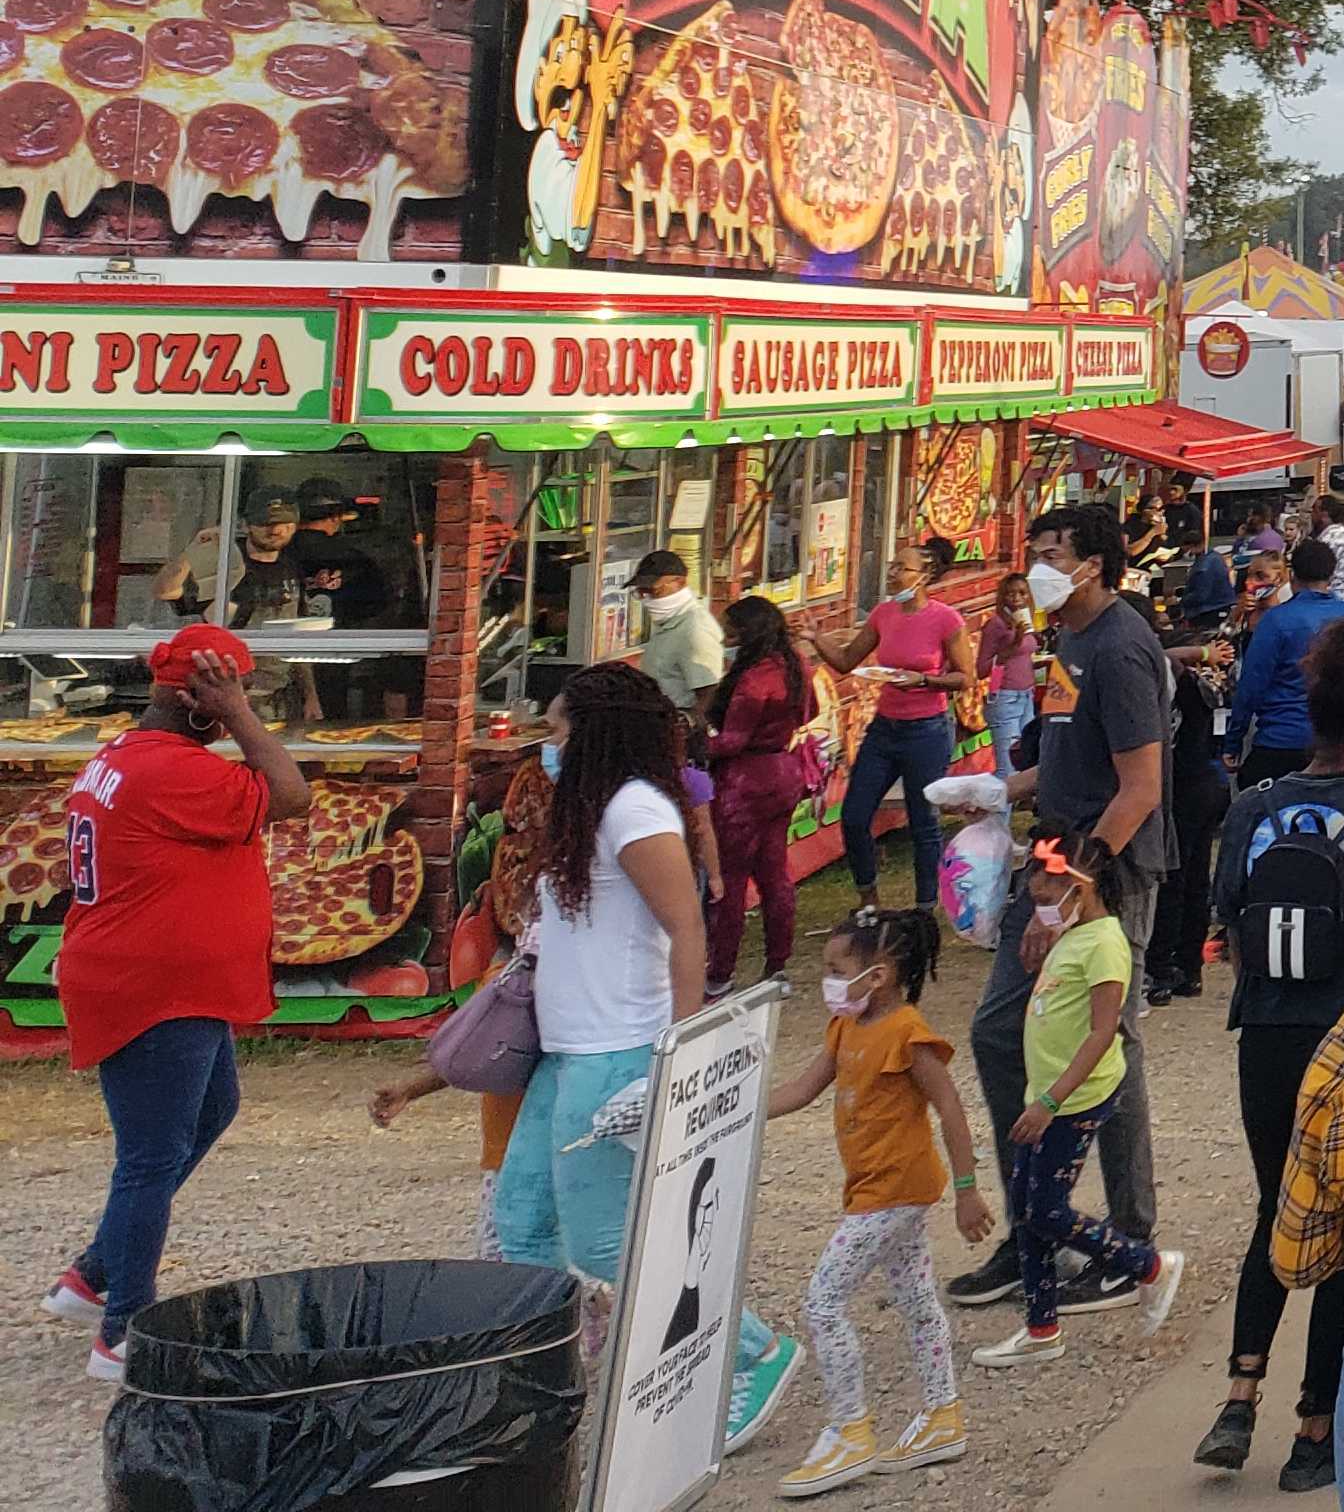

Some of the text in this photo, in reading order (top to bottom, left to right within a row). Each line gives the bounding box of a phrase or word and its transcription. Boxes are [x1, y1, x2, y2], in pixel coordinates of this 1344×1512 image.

[92, 332, 290, 395] PIZZA
[400, 334, 693, 396] COLD DRINKS
[732, 340, 902, 395] SAUSAGE PIZZA
[938, 340, 1054, 384] PEPPERONI PIZZA
[1116, 341, 1144, 376] PIZZA
[67, 812, 98, 905] 13
[670, 1070, 700, 1112] FACE
[684, 1085, 740, 1140] REQUIRED
[628, 1369, 656, 1401] COVER
[656, 1353, 678, 1379] YOUR
[634, 1375, 675, 1416] PREVENT
